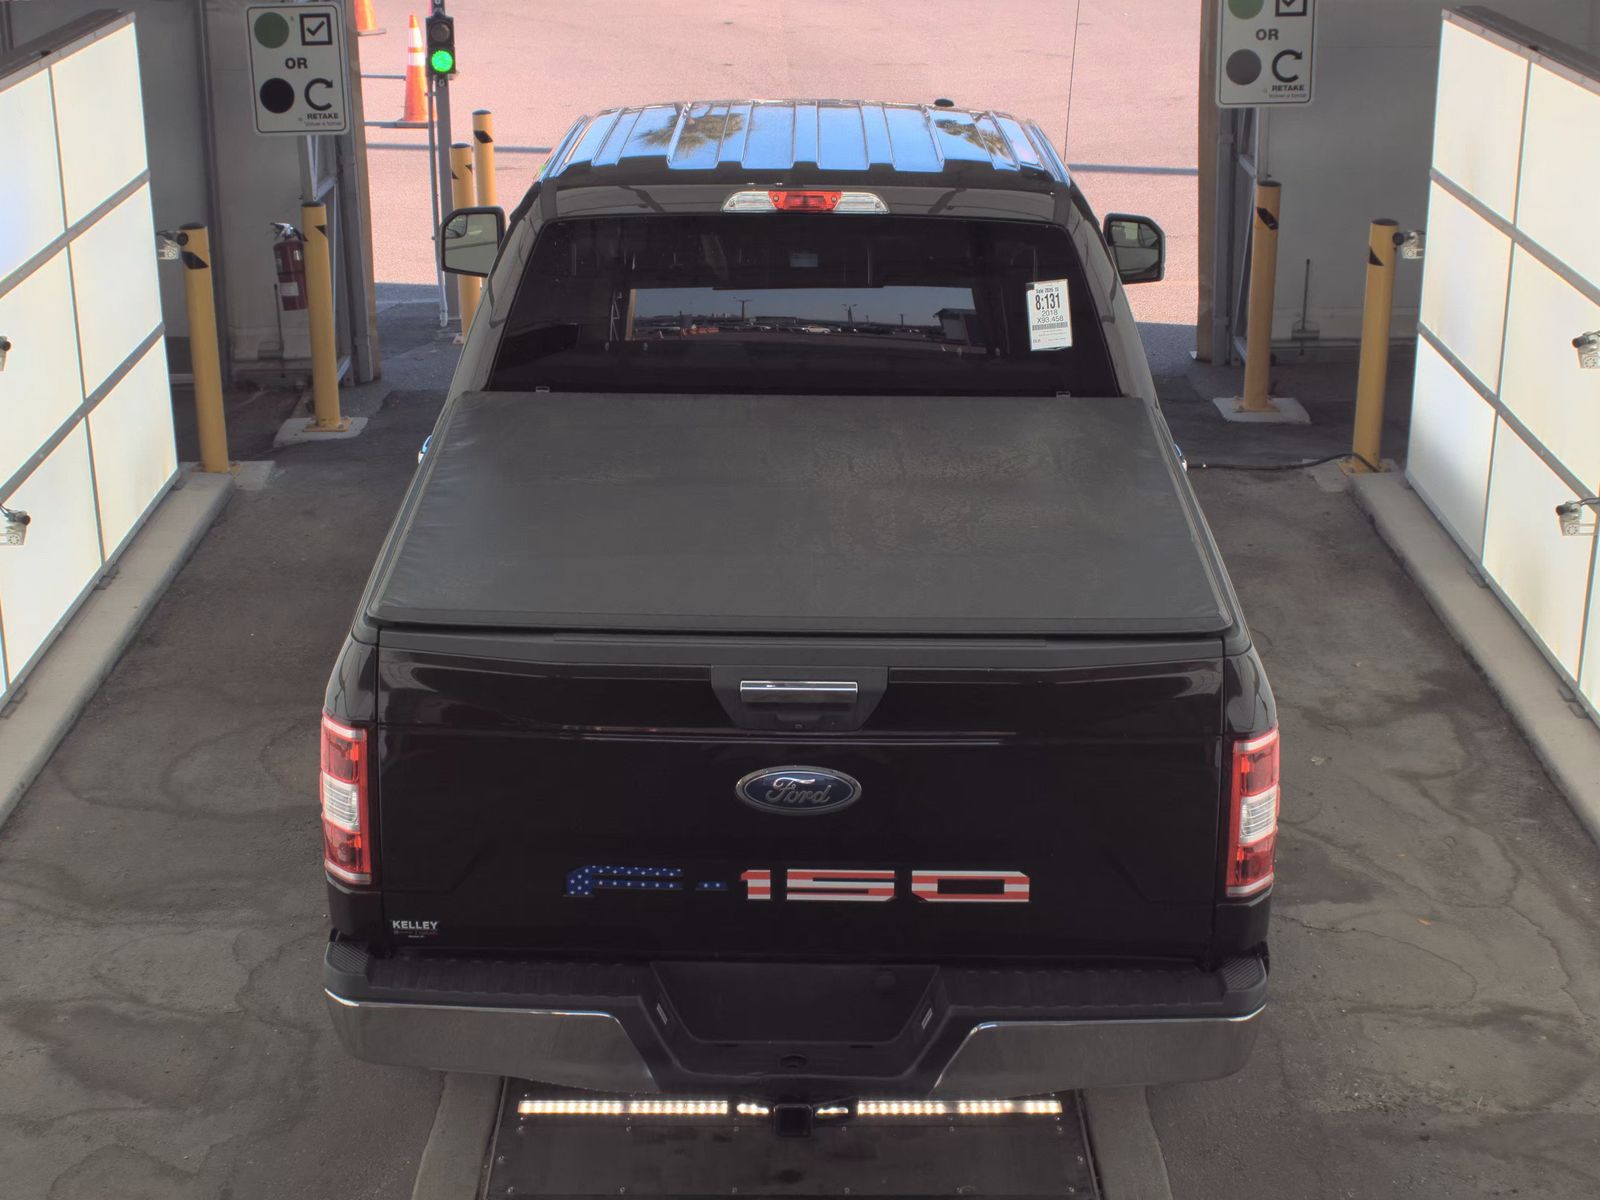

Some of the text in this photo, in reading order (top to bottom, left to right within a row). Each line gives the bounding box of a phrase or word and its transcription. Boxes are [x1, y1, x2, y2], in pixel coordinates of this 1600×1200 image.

[1255, 28, 1279, 41] OR
[284, 57, 308, 70] OR
[306, 112, 339, 120] RETAKE
[1035, 293, 1061, 310] 8:131
[1041, 309, 1058, 317] 2018
[765, 776, 832, 804] Ford
[565, 865, 1031, 903] F-150
[392, 920, 438, 930] KELLEY
